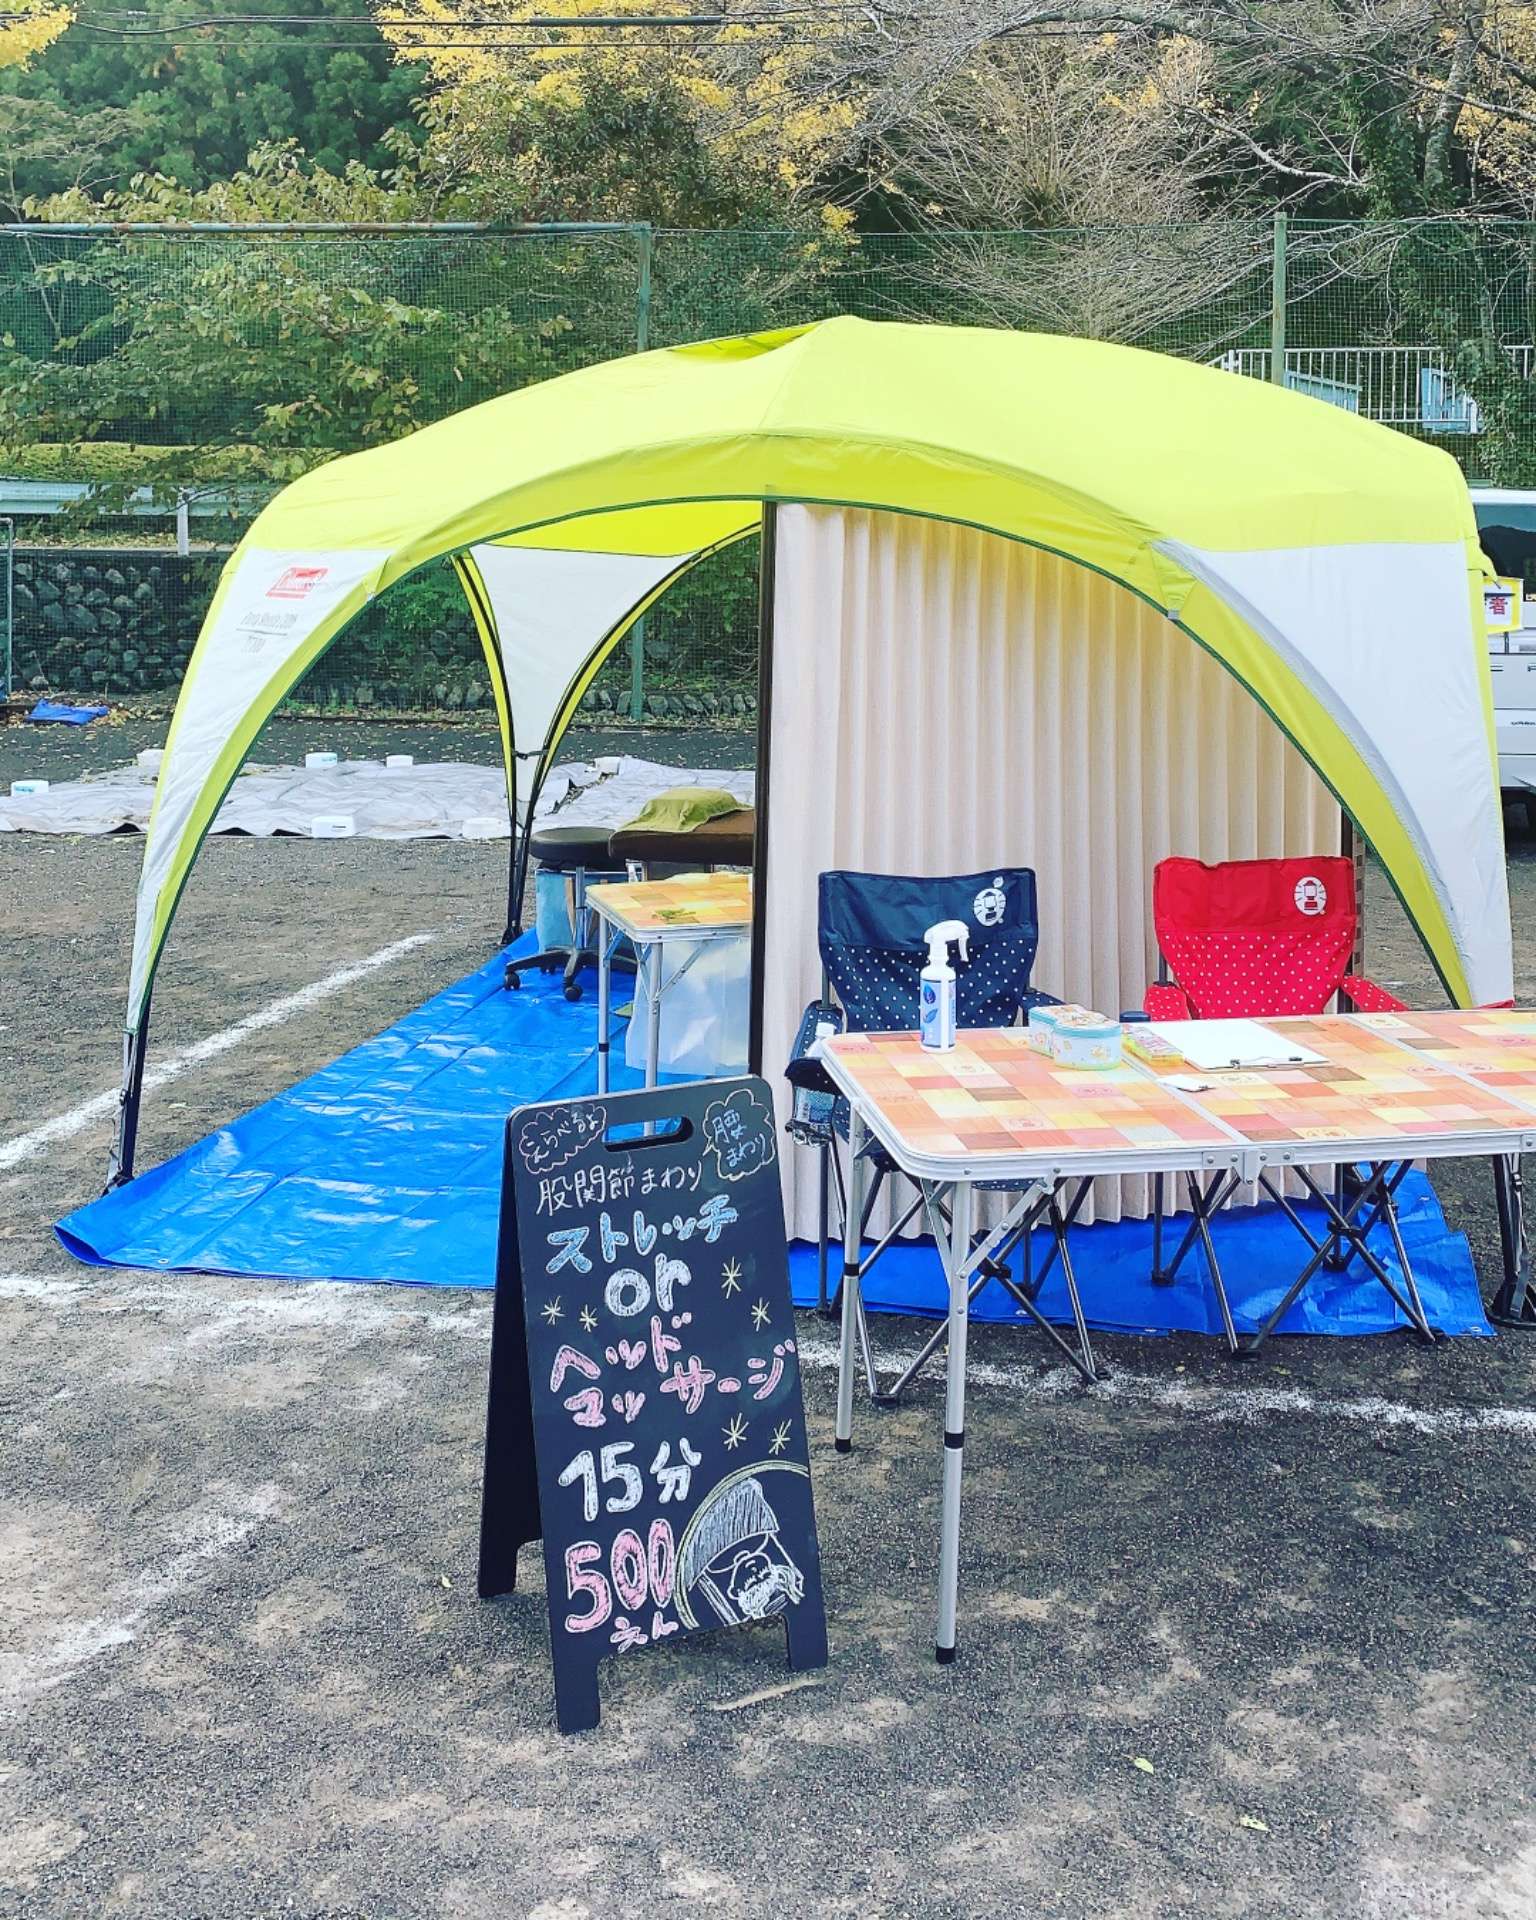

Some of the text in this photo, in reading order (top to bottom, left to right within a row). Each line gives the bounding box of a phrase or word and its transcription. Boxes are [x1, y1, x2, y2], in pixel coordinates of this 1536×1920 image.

[726, 1133, 765, 1167] まわり
[545, 1194, 738, 1274] ストレッチ
[604, 1252, 692, 1317] or
[549, 1312, 692, 1393] ヘッド
[563, 1339, 796, 1428] マッサージ
[558, 1437, 701, 1521] 15分
